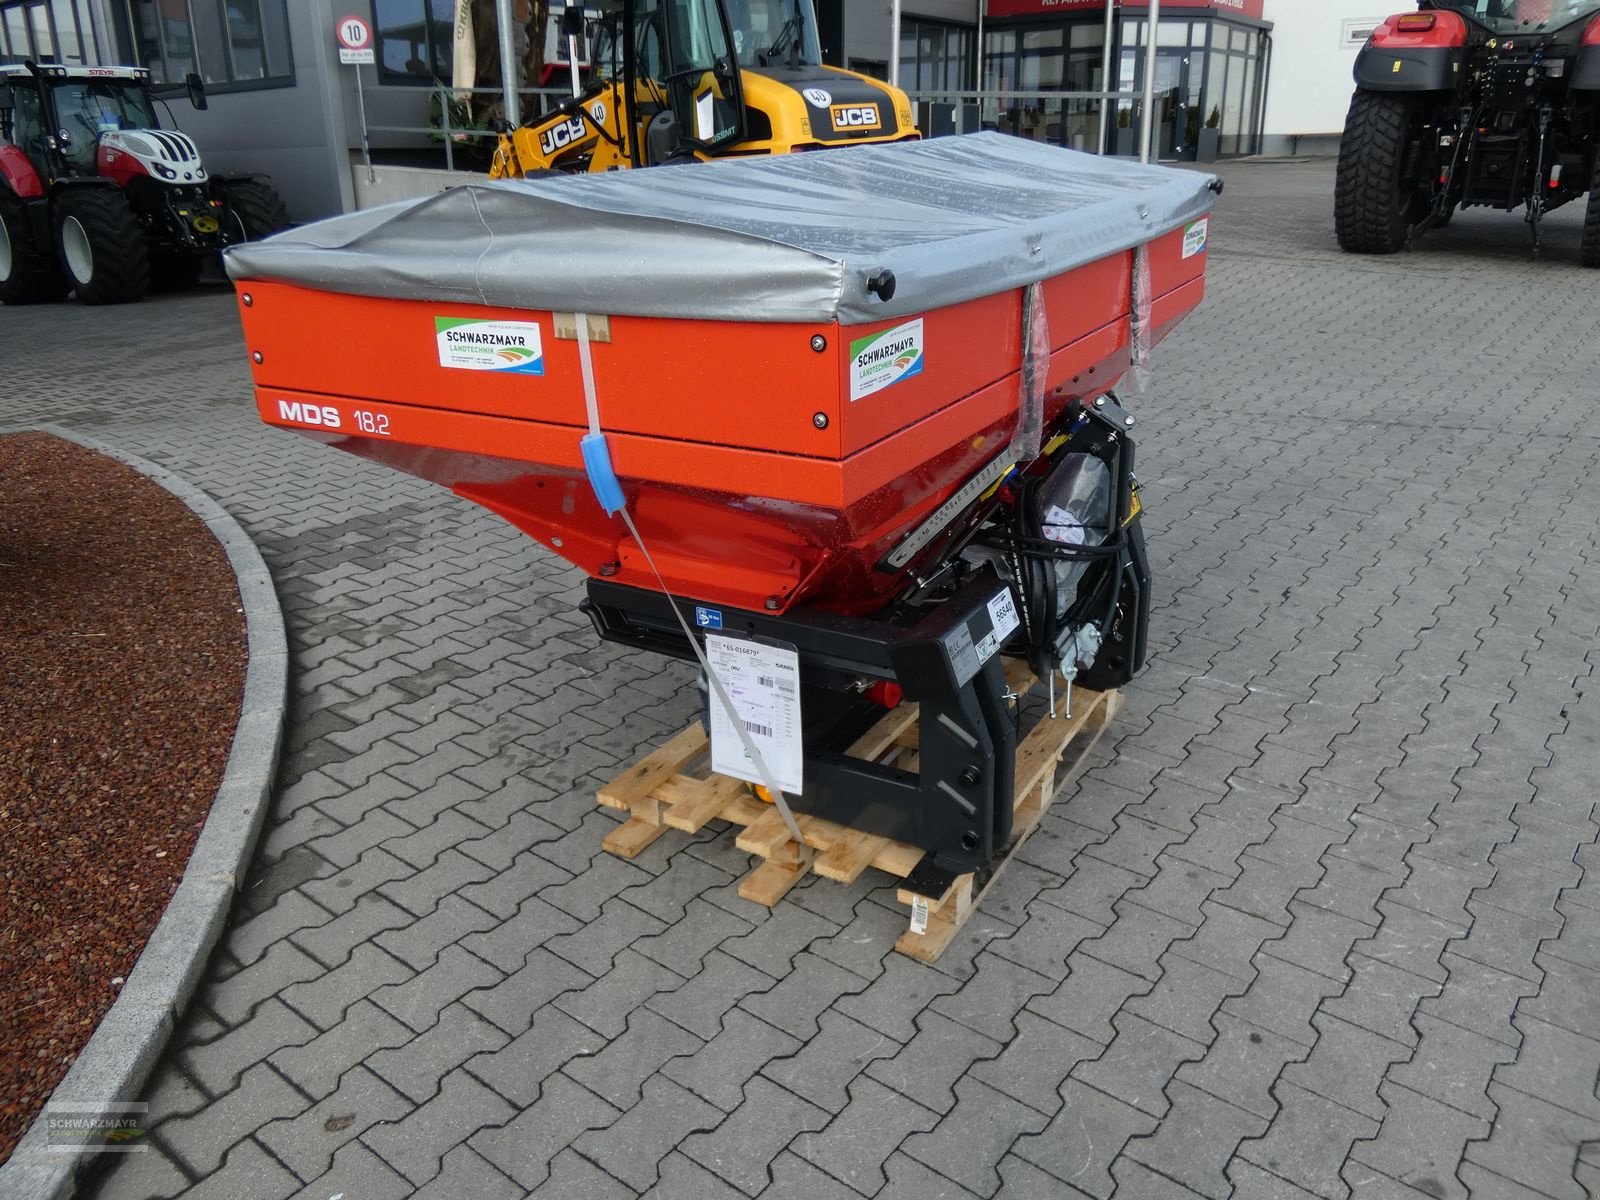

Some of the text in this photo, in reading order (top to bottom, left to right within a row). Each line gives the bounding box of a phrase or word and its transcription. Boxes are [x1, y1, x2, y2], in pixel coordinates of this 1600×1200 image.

[347, 25, 361, 41] 10
[808, 90, 826, 102] 40
[594, 105, 604, 121] 40
[836, 108, 877, 126] JCB
[542, 117, 586, 154] JCB
[446, 331, 526, 347] SCHWARZMAYR
[449, 344, 495, 354] LANDTECHNIK
[858, 336, 914, 368] SCHWARZMAYR
[859, 359, 893, 379] LANDTECHNIK
[278, 399, 391, 436] MDS 18.2
